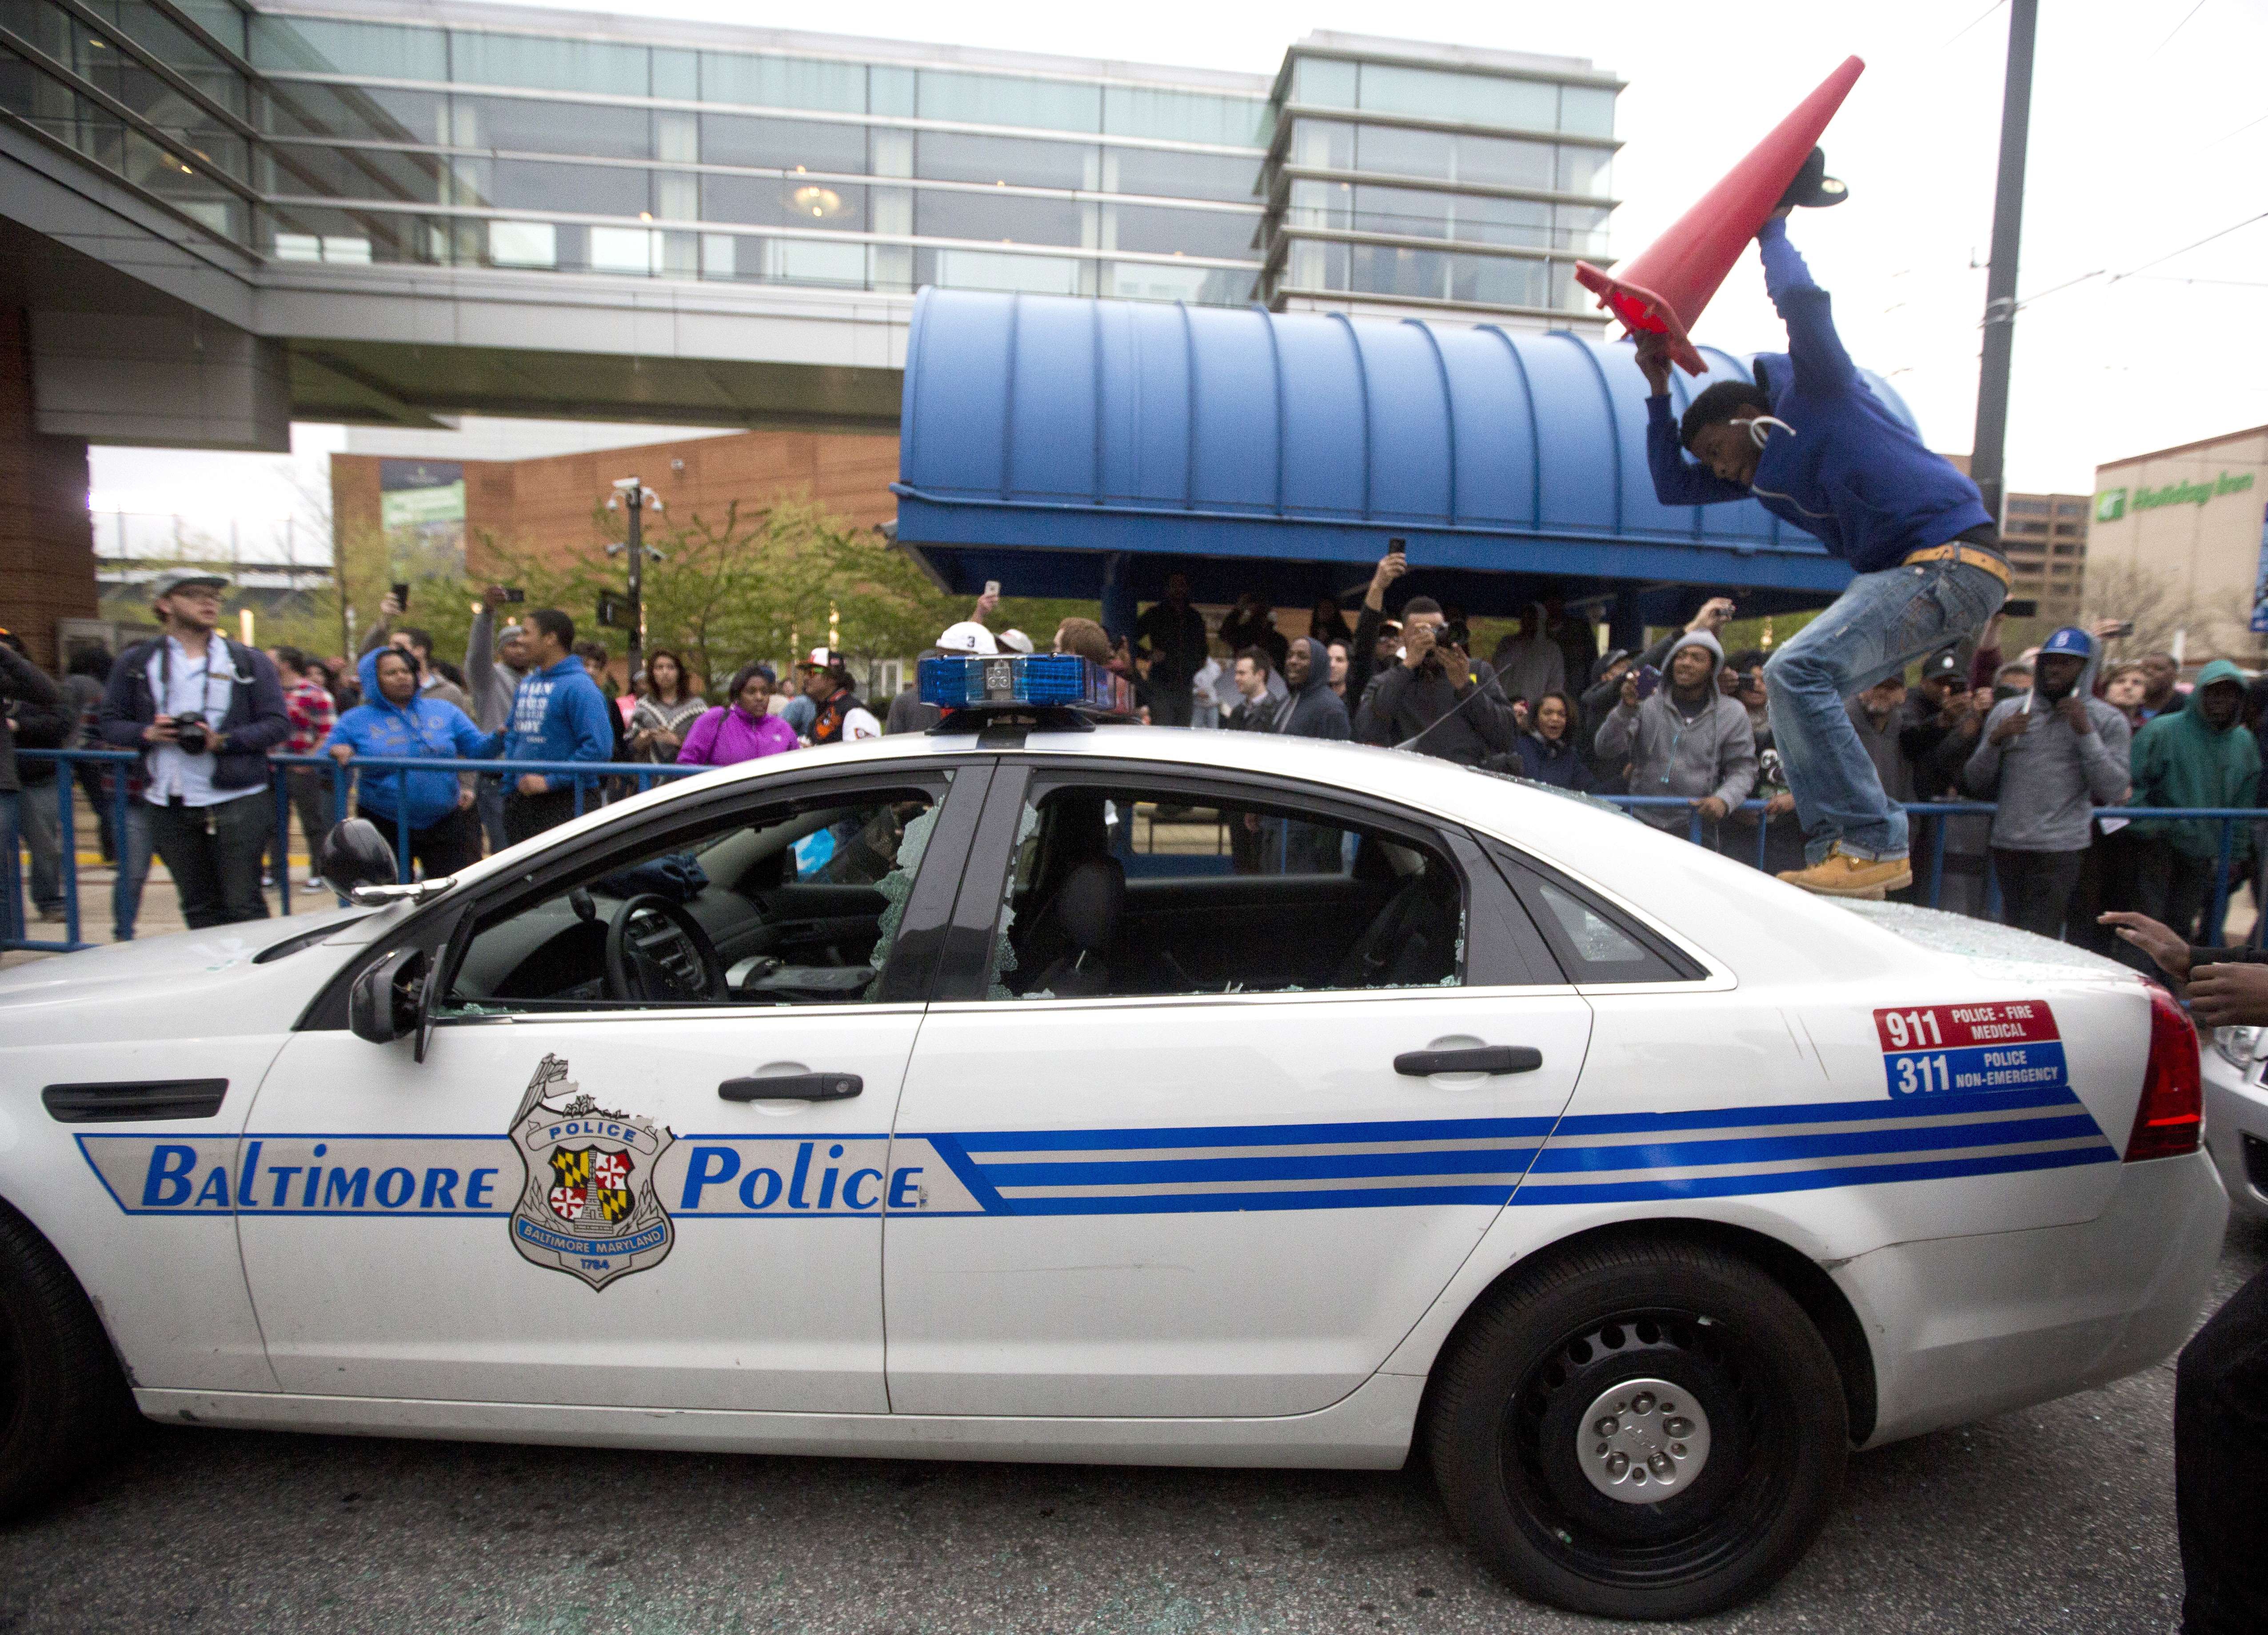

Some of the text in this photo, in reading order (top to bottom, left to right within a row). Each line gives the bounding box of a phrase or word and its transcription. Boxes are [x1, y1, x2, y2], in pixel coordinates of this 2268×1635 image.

[967, 636, 975, 647] 3
[1952, 1008, 1996, 1024] POLICE
[2007, 1005, 2034, 1021] FIRE
[1886, 1010, 1942, 1048] 911
[1971, 1023, 2027, 1041] MEDICAL
[1984, 1050, 2027, 1068] POLICE
[1897, 1054, 1950, 1094] 311
[1956, 1068, 2058, 1088] NON-EMERGENCY
[549, 1122, 637, 1143] POLICE
[524, 1225, 662, 1253] BALTIMORE MARYLAND
